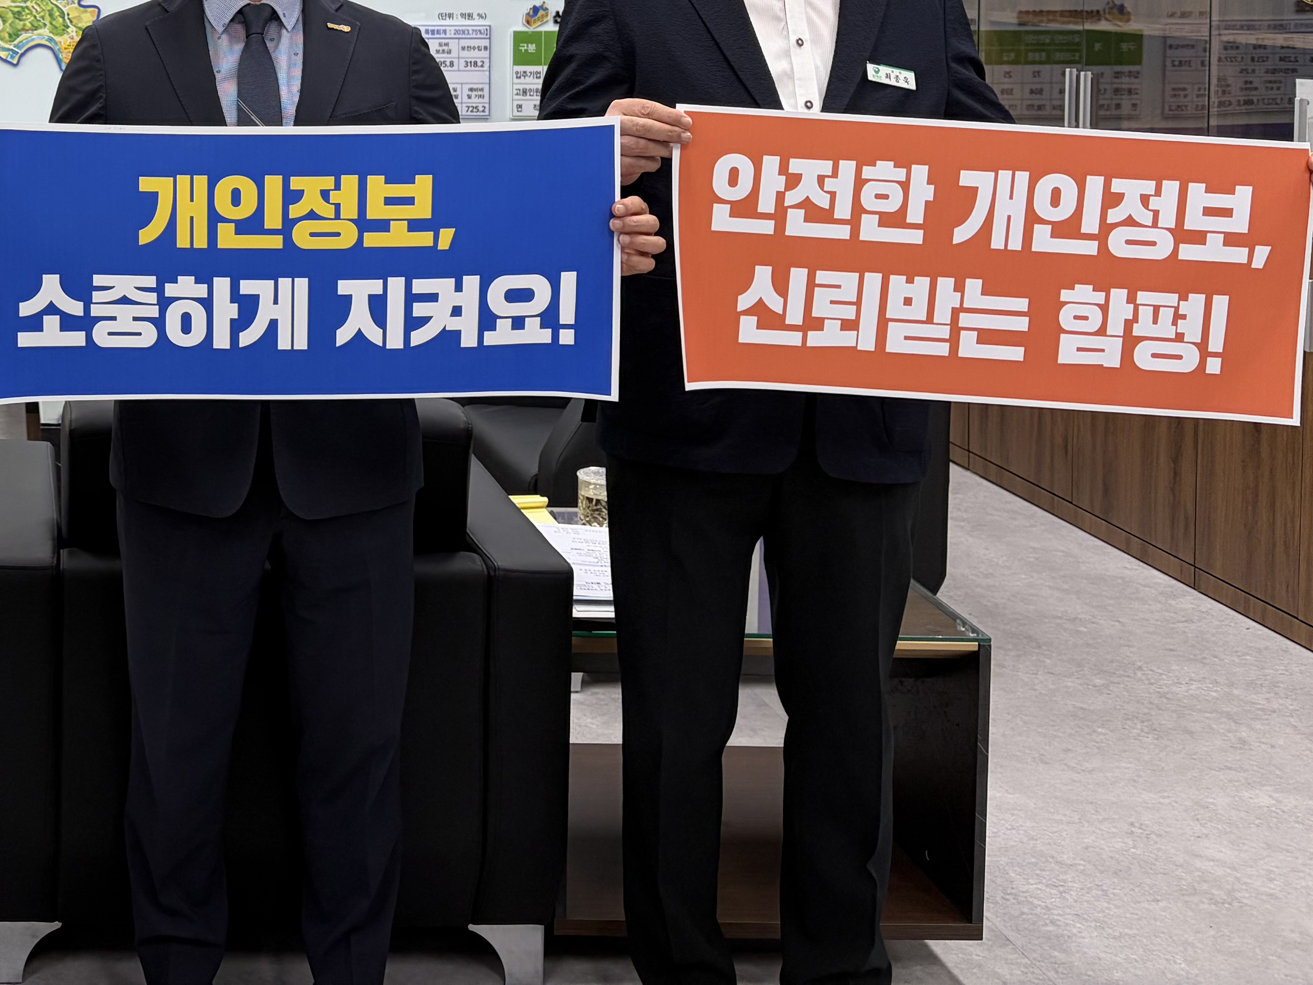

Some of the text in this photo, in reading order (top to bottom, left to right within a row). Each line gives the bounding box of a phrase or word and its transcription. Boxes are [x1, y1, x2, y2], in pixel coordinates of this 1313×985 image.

[463, 60, 485, 68] 318.2
[519, 43, 537, 53] 구분
[515, 71, 542, 80] 입주기업
[465, 106, 487, 114] 725.2
[138, 174, 456, 250] 개인정보,
[711, 153, 1271, 269] 안전한 개인정보,
[17, 271, 578, 351] 소중하게 지켜요!
[737, 265, 1229, 375] 신뢰받는 함평!
